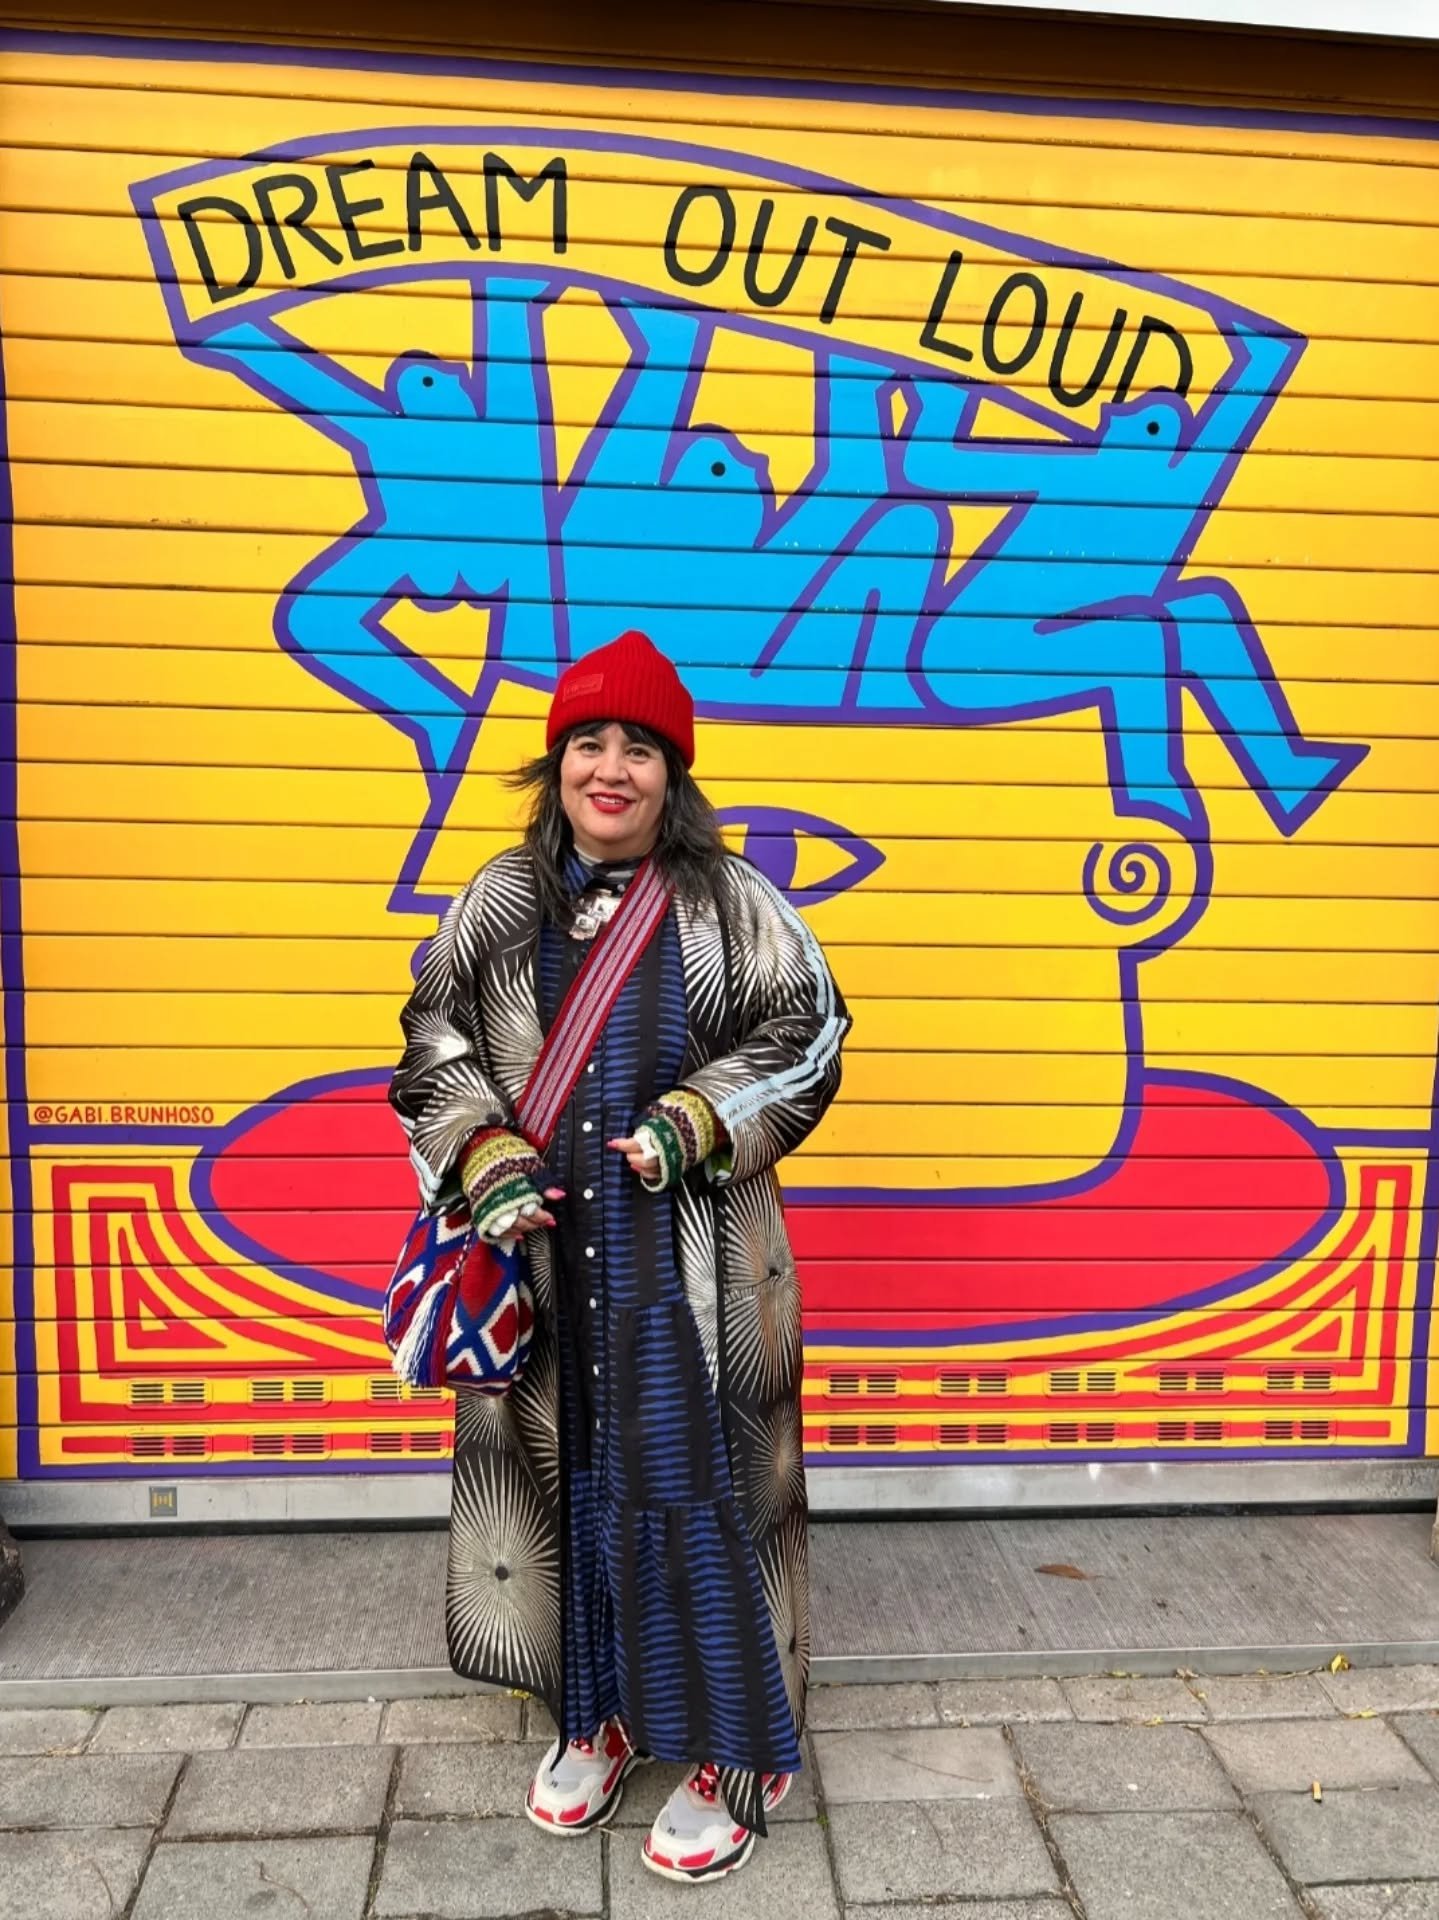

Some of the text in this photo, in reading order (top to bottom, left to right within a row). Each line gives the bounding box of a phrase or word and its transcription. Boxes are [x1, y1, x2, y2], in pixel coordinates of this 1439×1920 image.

[178, 151, 1192, 408] DREAM OUT LOUD
[34, 1106, 214, 1124] @GABI.BRUNHOSO
